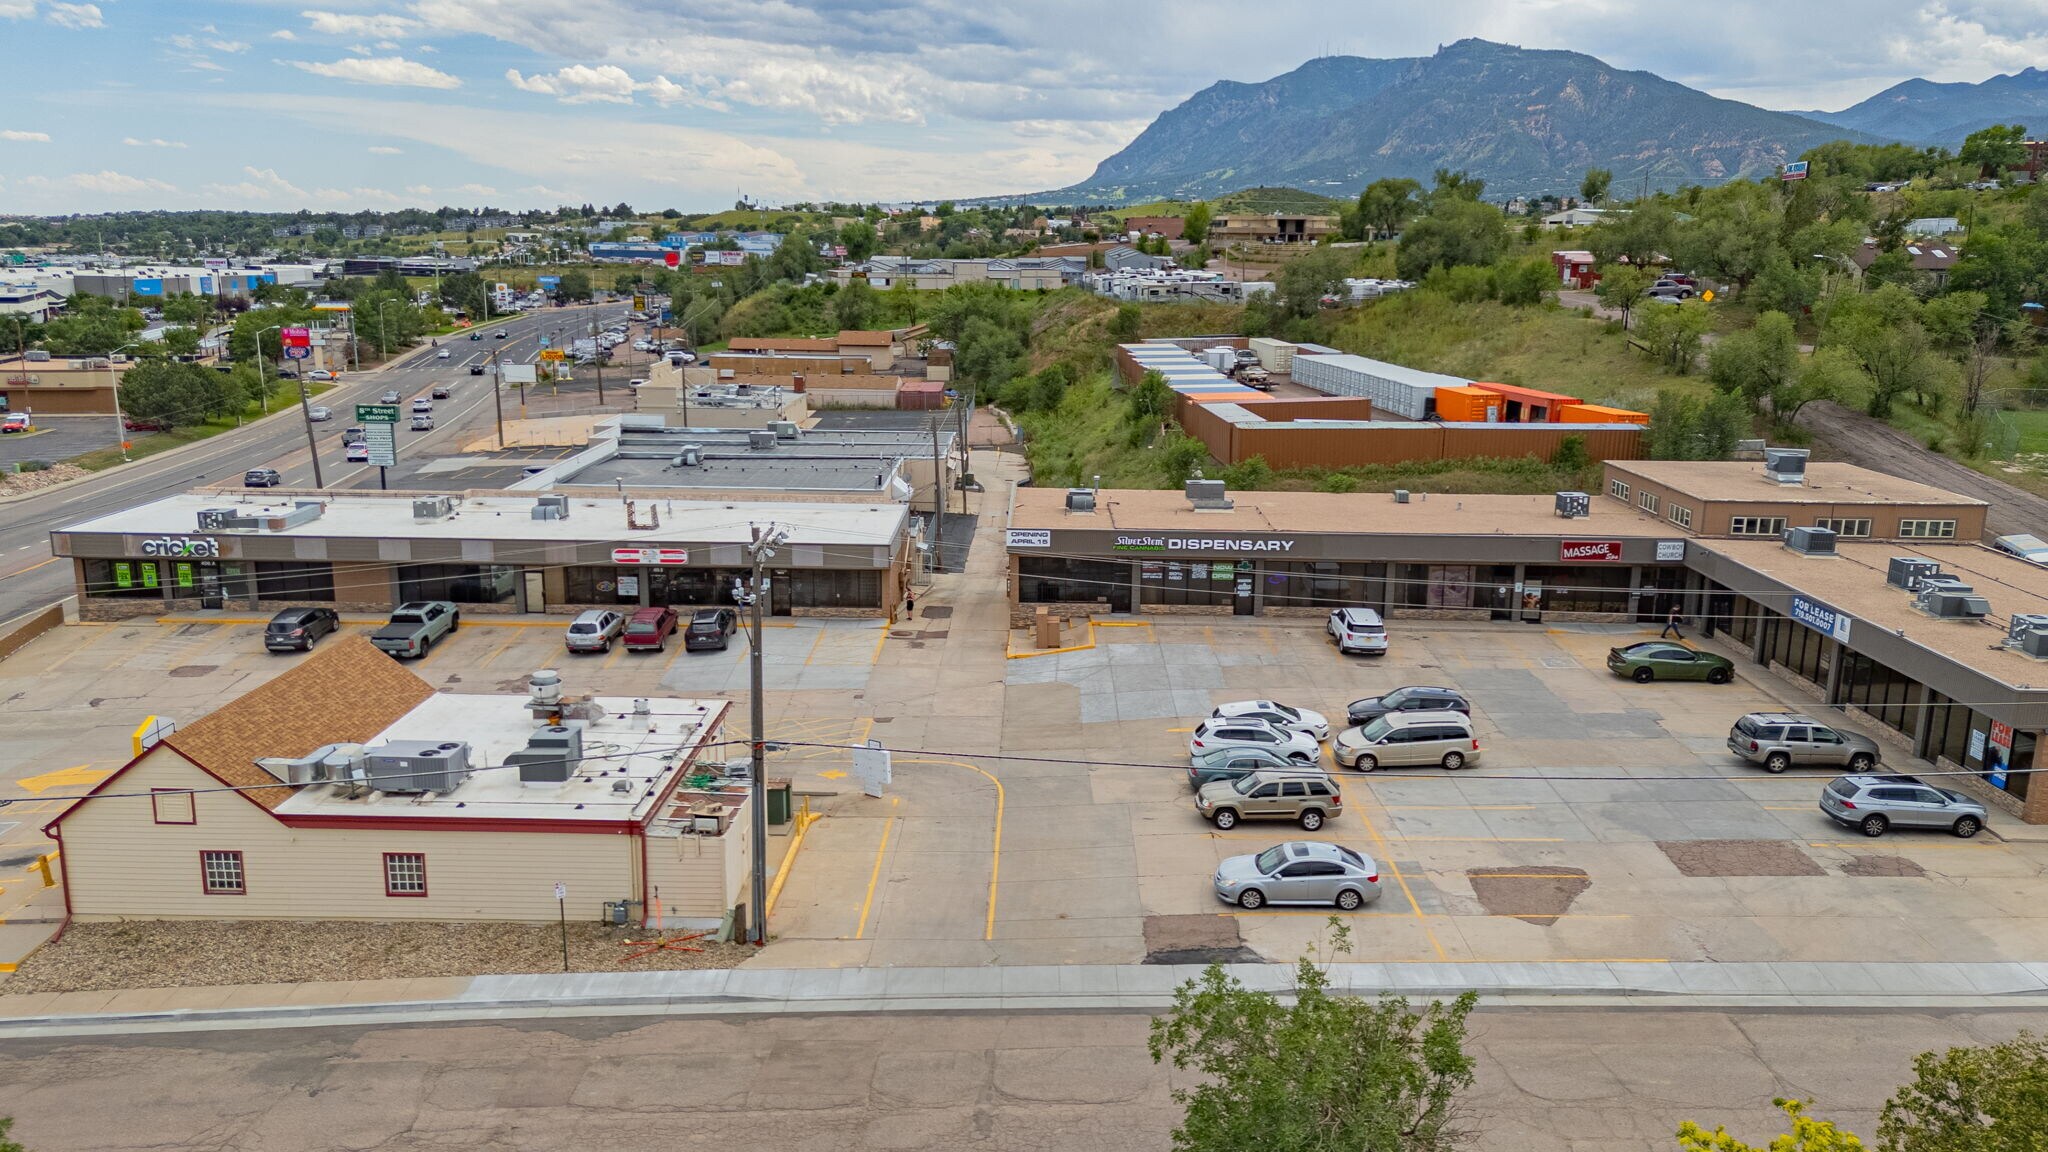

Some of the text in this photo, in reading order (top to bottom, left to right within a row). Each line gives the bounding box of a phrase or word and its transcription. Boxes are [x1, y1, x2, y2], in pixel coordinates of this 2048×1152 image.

[141, 536, 219, 558] cricket
[1167, 538, 1295, 551] DISPENSARY
[1563, 543, 1610, 559] MASSAGE
[1658, 543, 1684, 551] COWBOY
[1605, 552, 1619, 561] Spa
[1657, 551, 1683, 559] CHURCH
[1794, 598, 1835, 624] FOR LEASE
[1794, 608, 1832, 631] 719.501.0007
[1992, 720, 2012, 738] FOR
